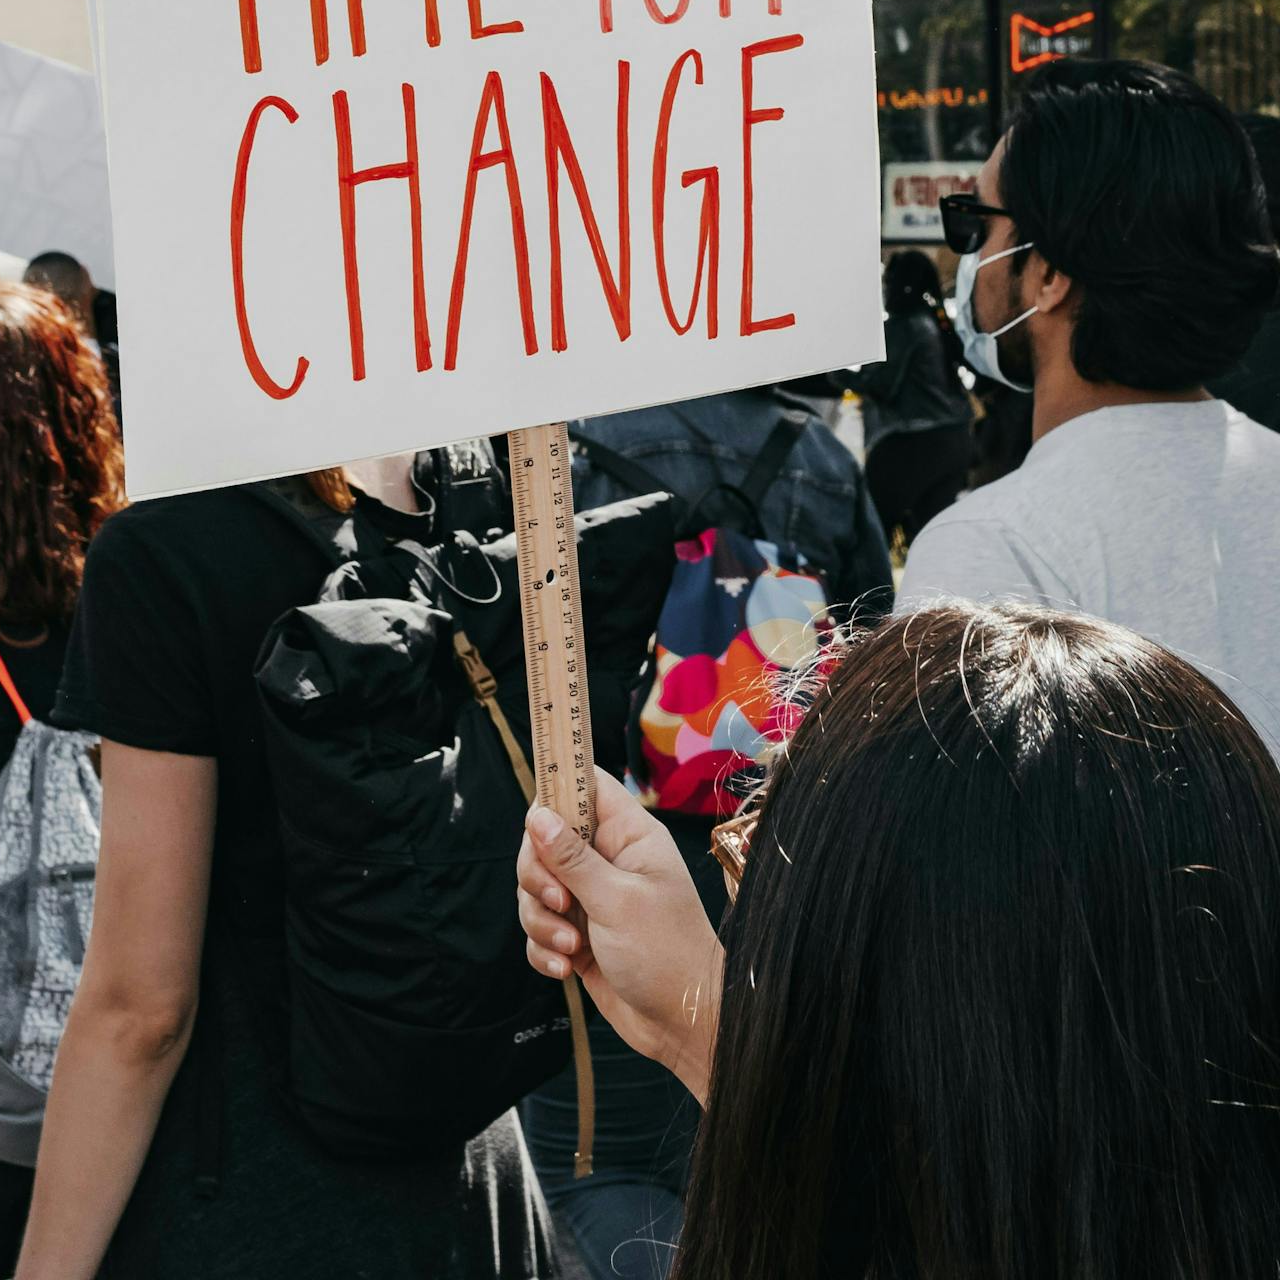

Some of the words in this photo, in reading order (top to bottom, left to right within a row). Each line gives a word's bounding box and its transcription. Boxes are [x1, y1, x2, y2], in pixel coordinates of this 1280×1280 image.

[230, 34, 804, 400] CHANGE
[549, 442, 559, 457] 10
[551, 466, 561, 480] 11
[553, 491, 563, 506] 12
[555, 515, 565, 529] 13
[557, 539, 566, 553] 14
[559, 563, 569, 577] 15
[561, 587, 571, 602] 16
[563, 611, 573, 625] 17
[565, 635, 575, 649] 18
[567, 658, 576, 673] 19
[569, 681, 578, 697] 20
[571, 706, 580, 721] 21
[572, 729, 582, 745] 22
[574, 753, 584, 769] 23
[576, 777, 586, 792] 24
[578, 800, 588, 816] 25
[580, 824, 590, 840] 26
